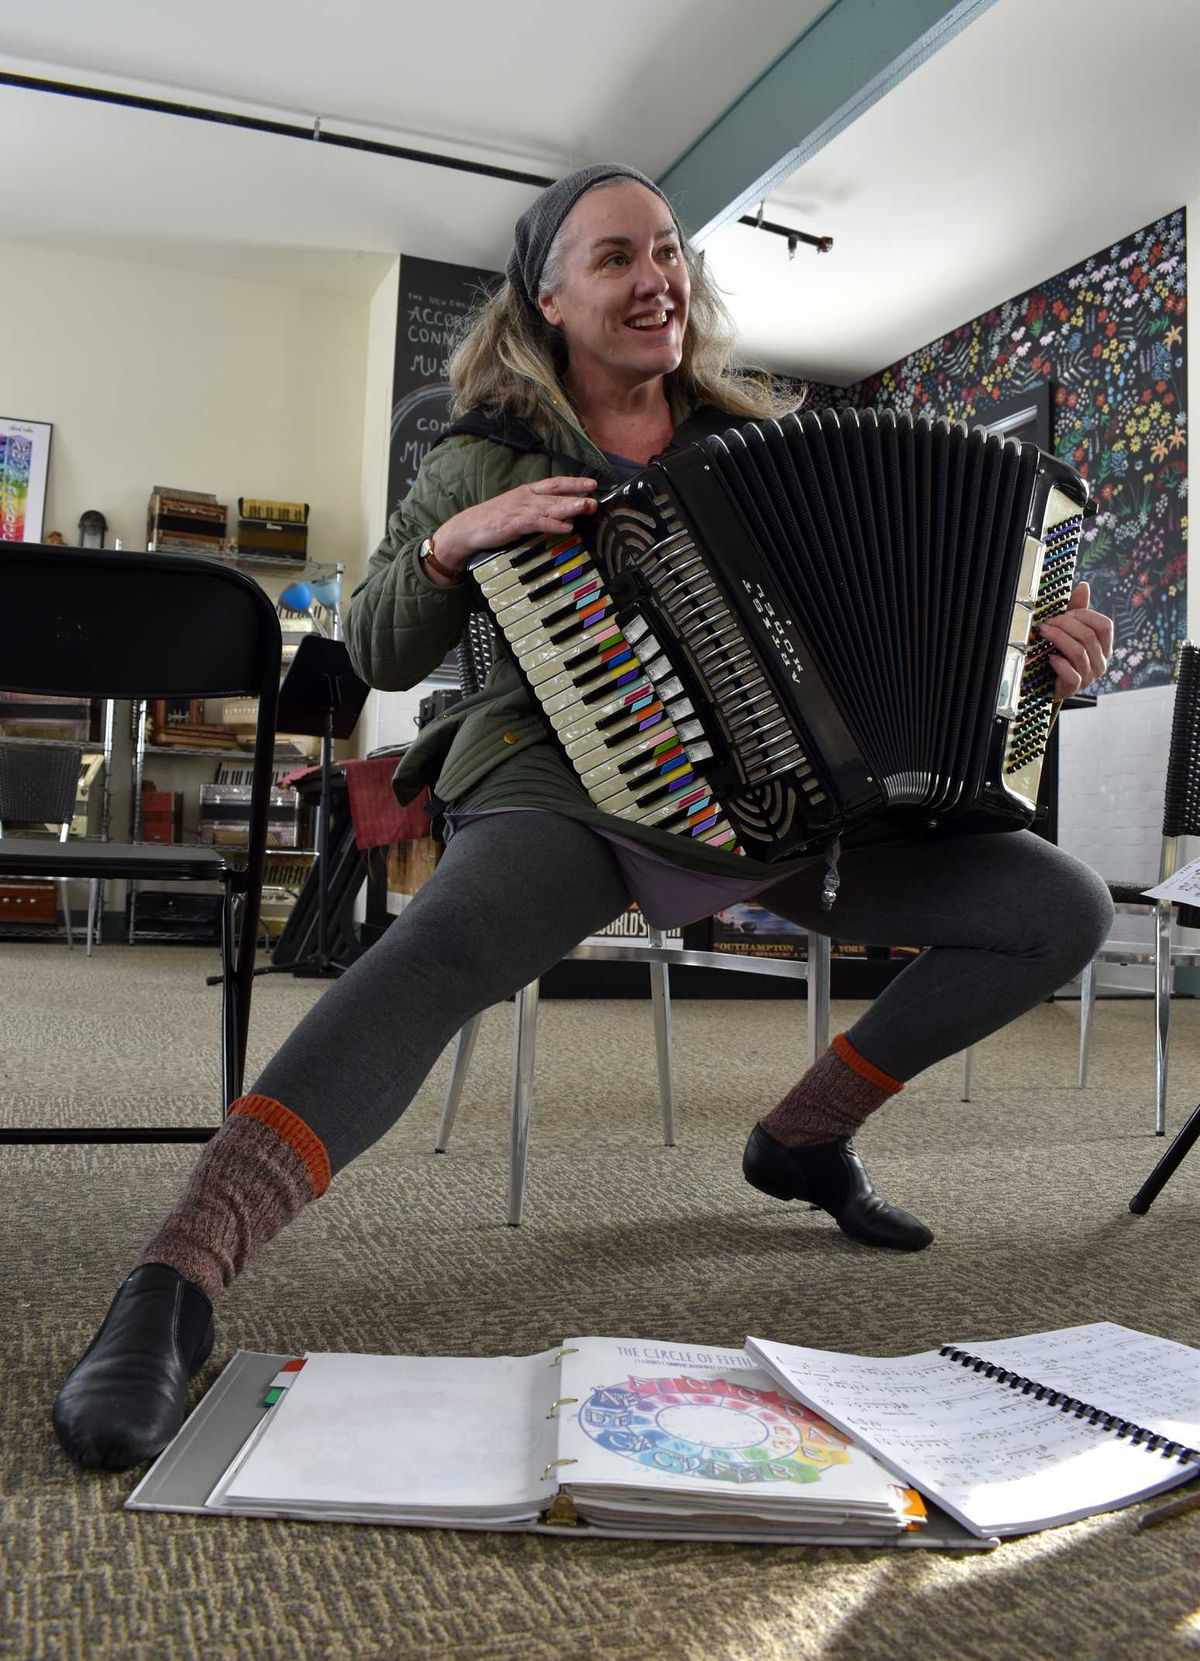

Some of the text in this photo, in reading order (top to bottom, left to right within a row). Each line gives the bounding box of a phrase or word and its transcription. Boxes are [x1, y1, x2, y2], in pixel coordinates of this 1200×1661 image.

[407, 306, 465, 328] ACCOR
[408, 325, 450, 344] CONN
[409, 354, 450, 376] MUS
[416, 417, 454, 433] COM
[400, 440, 431, 470] MU
[595, 909, 648, 937] ORLD'S
[617, 1346, 640, 1358] THE
[643, 1347, 693, 1363] CIRCLE
[696, 1352, 714, 1364] OF
